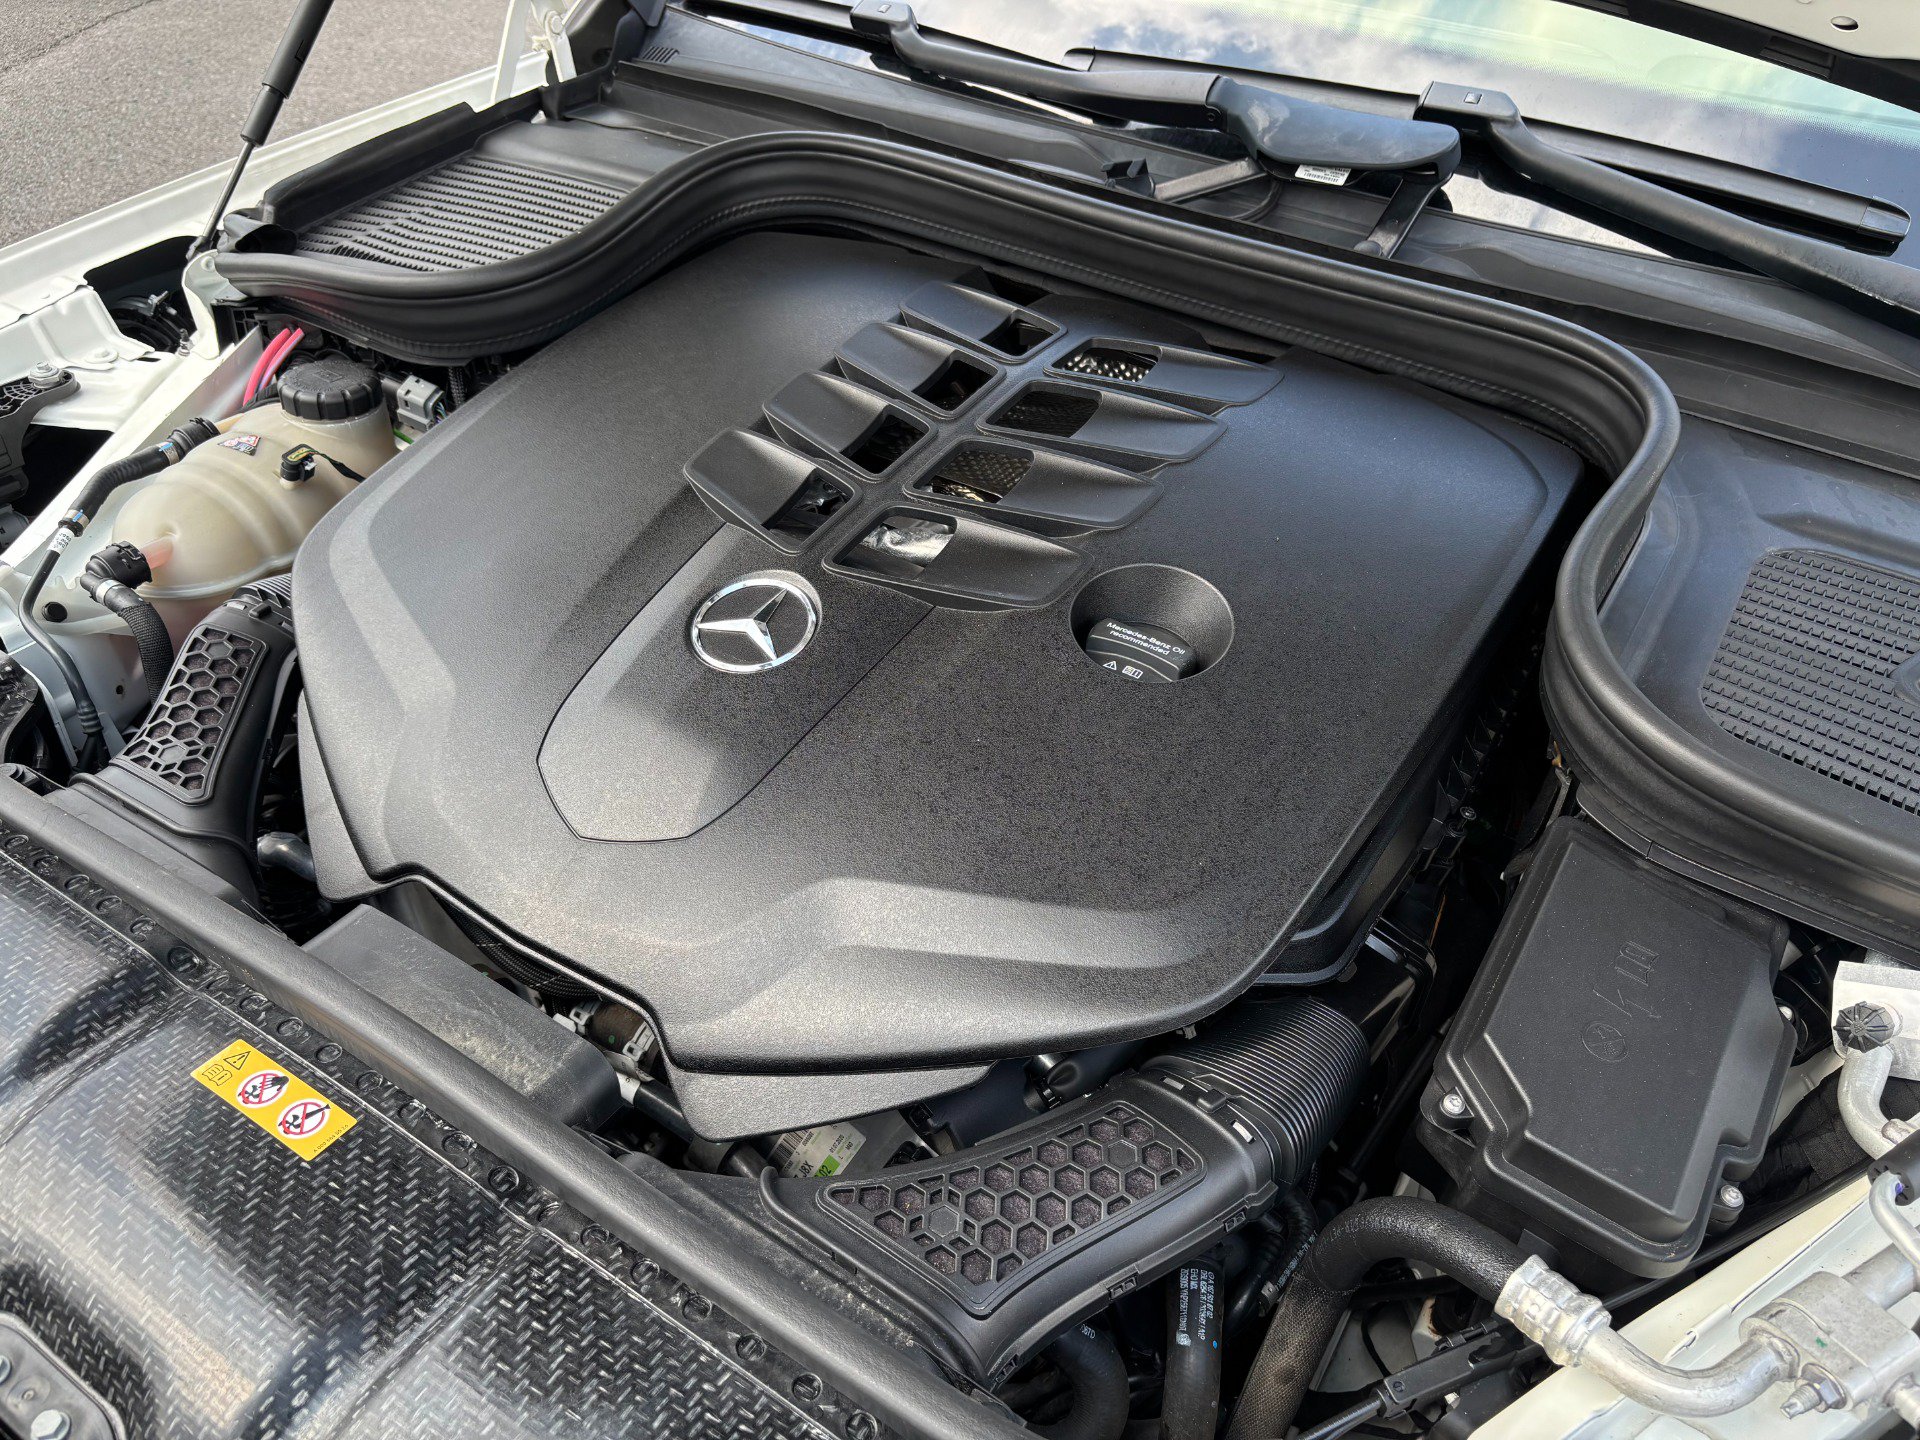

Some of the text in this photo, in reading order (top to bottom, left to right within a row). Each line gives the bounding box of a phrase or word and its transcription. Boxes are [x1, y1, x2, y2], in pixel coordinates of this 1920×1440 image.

[1106, 622, 1186, 655] Mercedes-Benz Oil
[1109, 630, 1171, 655] recommended
[798, 1160, 815, 1178] J8X
